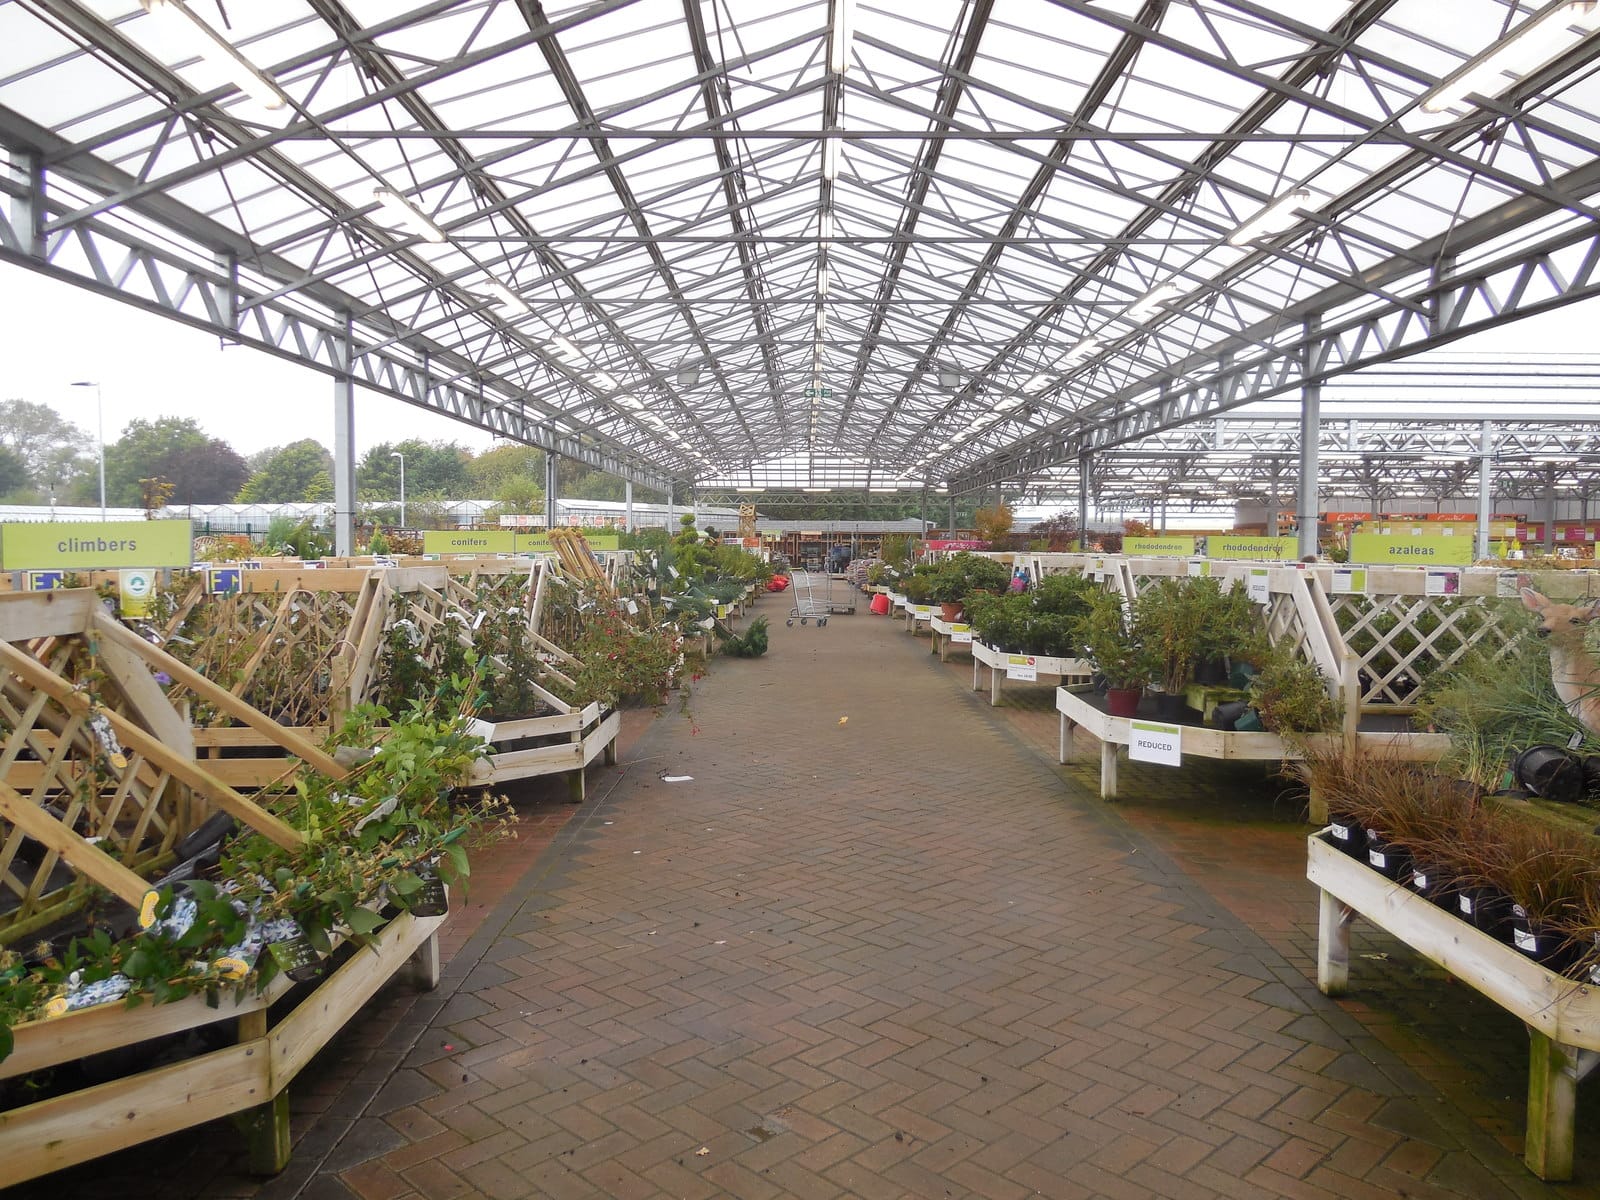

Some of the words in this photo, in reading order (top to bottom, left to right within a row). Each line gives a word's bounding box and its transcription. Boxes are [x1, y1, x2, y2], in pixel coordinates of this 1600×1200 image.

[58, 537, 137, 553] climbers
[451, 538, 487, 546] conifers
[1134, 543, 1183, 551] rhododendron
[1222, 543, 1284, 553] rhododendron
[1389, 544, 1434, 555] azaleas
[1137, 740, 1173, 751] REDUCED
